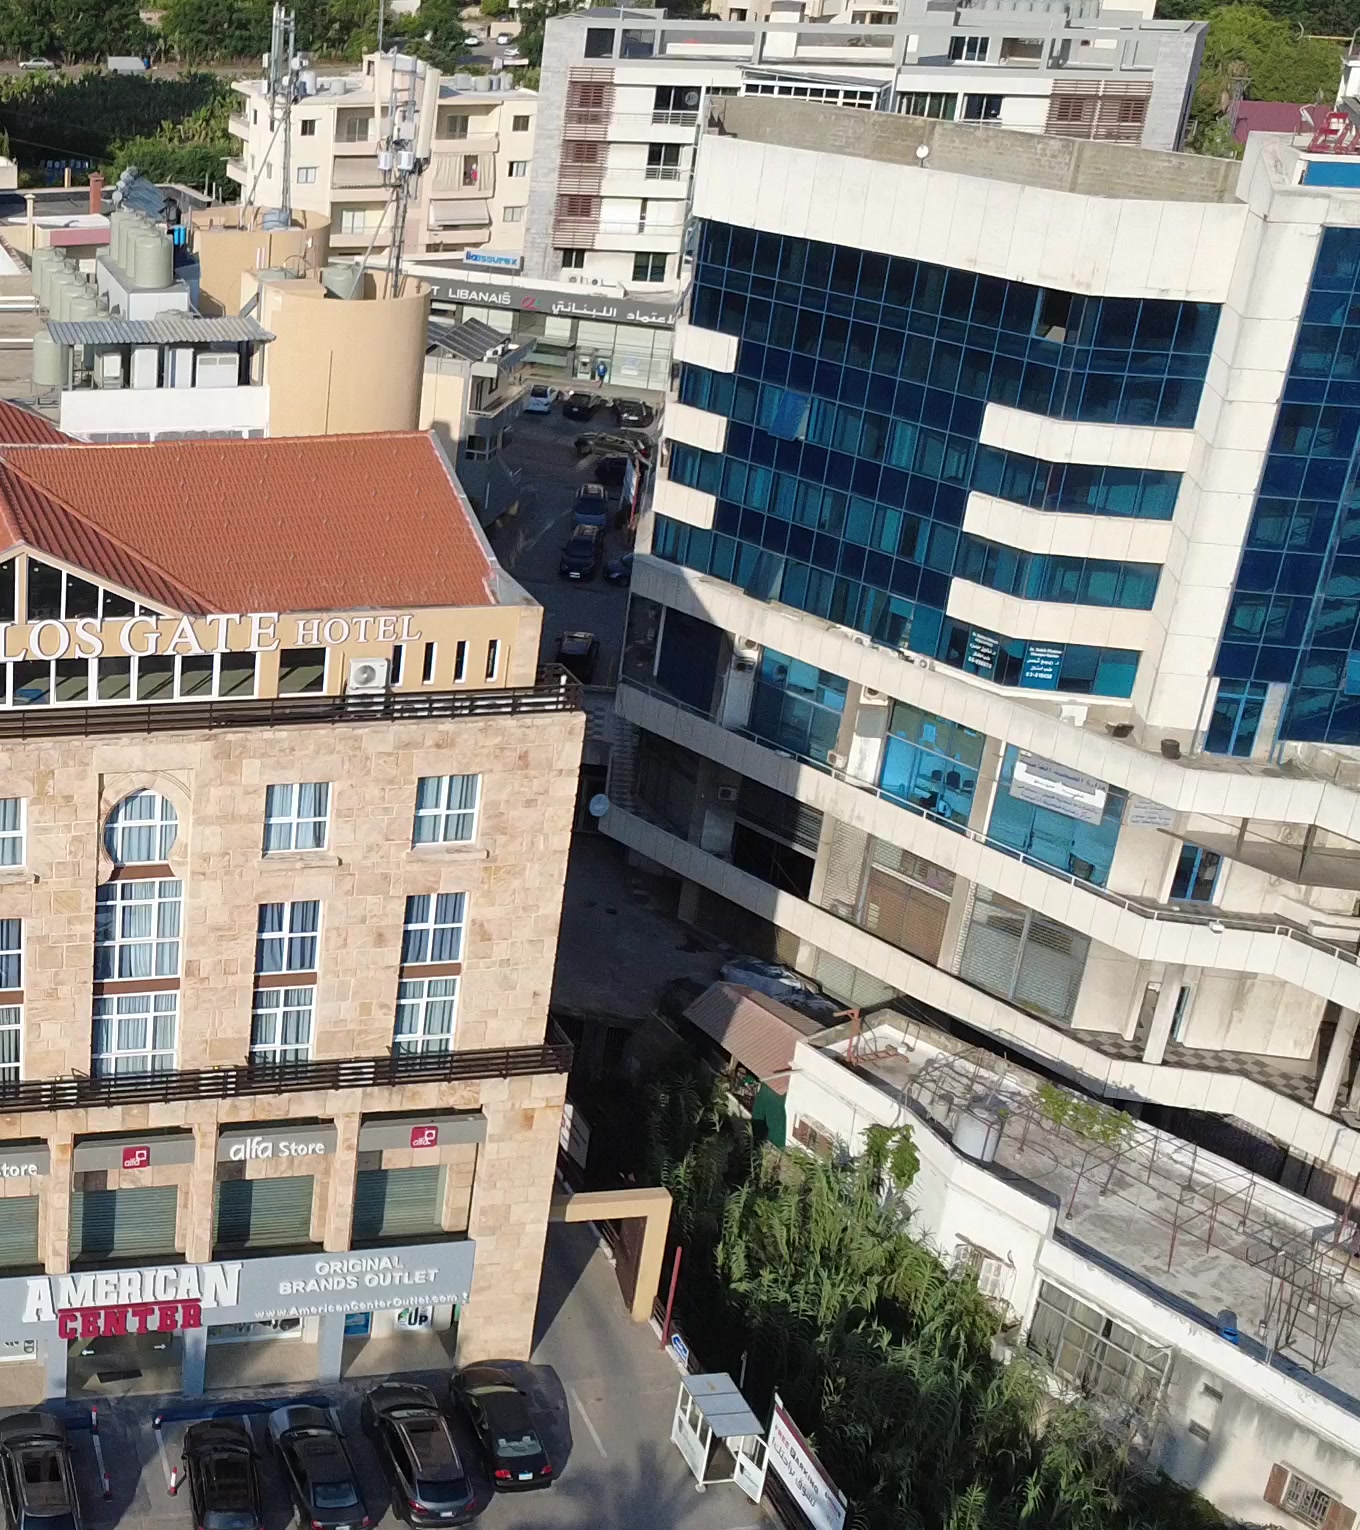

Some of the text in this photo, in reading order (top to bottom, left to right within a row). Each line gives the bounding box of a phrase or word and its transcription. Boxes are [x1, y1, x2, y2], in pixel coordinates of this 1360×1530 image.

[119, 612, 281, 657] GATE
[295, 614, 422, 646] HOTEL
[230, 1136, 325, 1160] alfa Store
[315, 1256, 405, 1276] ORIGINAL
[22, 1263, 243, 1323] AMERICAN
[279, 1269, 439, 1296] BRANDS OUTLET
[255, 1293, 458, 1319] www.AmericanCenterOutlet.com
[58, 1303, 202, 1340] CENTER
